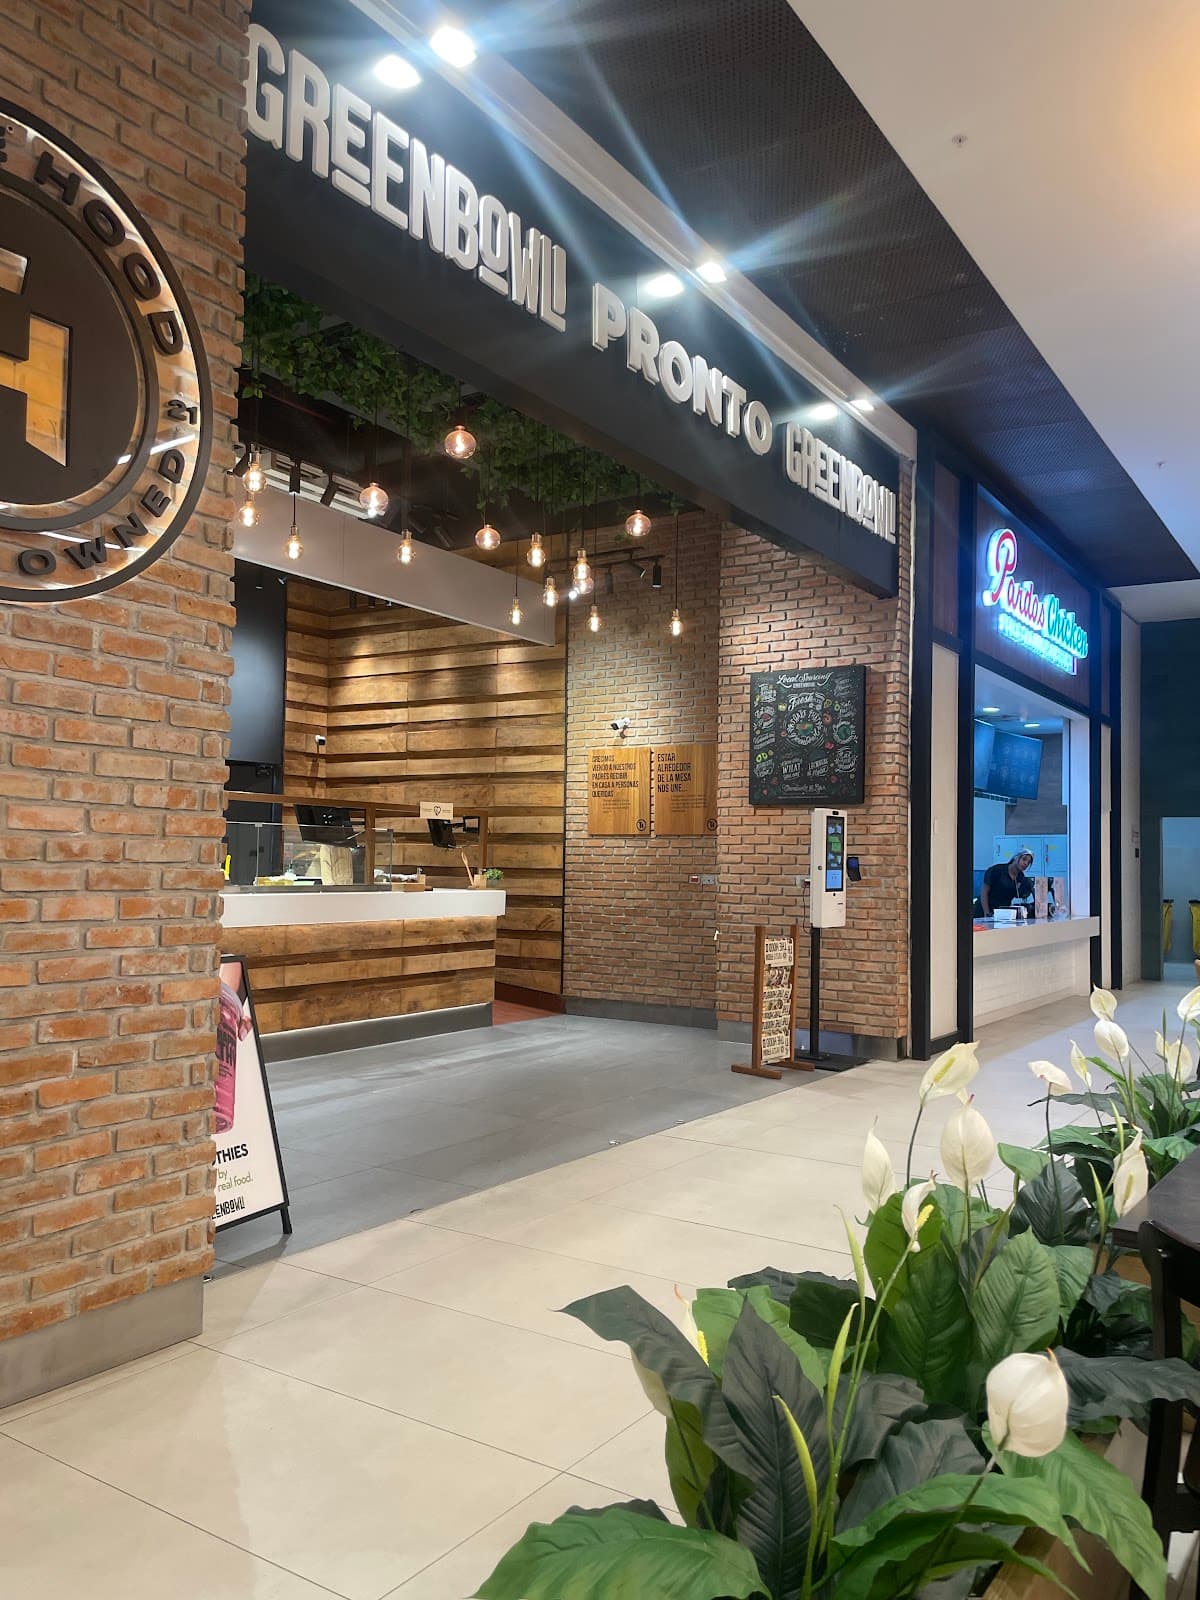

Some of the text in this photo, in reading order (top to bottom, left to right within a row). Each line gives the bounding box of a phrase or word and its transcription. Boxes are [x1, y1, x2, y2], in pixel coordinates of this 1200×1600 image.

[34, 151, 183, 355] HOOD
[592, 282, 773, 456] PRONTO
[18, 449, 186, 576] OWNED
[983, 529, 1045, 630] Pardos
[1044, 594, 1088, 658] Chicken
[657, 753, 676, 762] ESTAR
[657, 763, 692, 773] ALREDEDOR
[599, 781, 611, 789] CASA
[616, 780, 639, 788] PERSONAS
[657, 772, 692, 783] DE LA MESA
[657, 784, 669, 793] NOS
[212, 1144, 249, 1166] THIES
[217, 1168, 228, 1180] by
[217, 1171, 254, 1192] real food.
